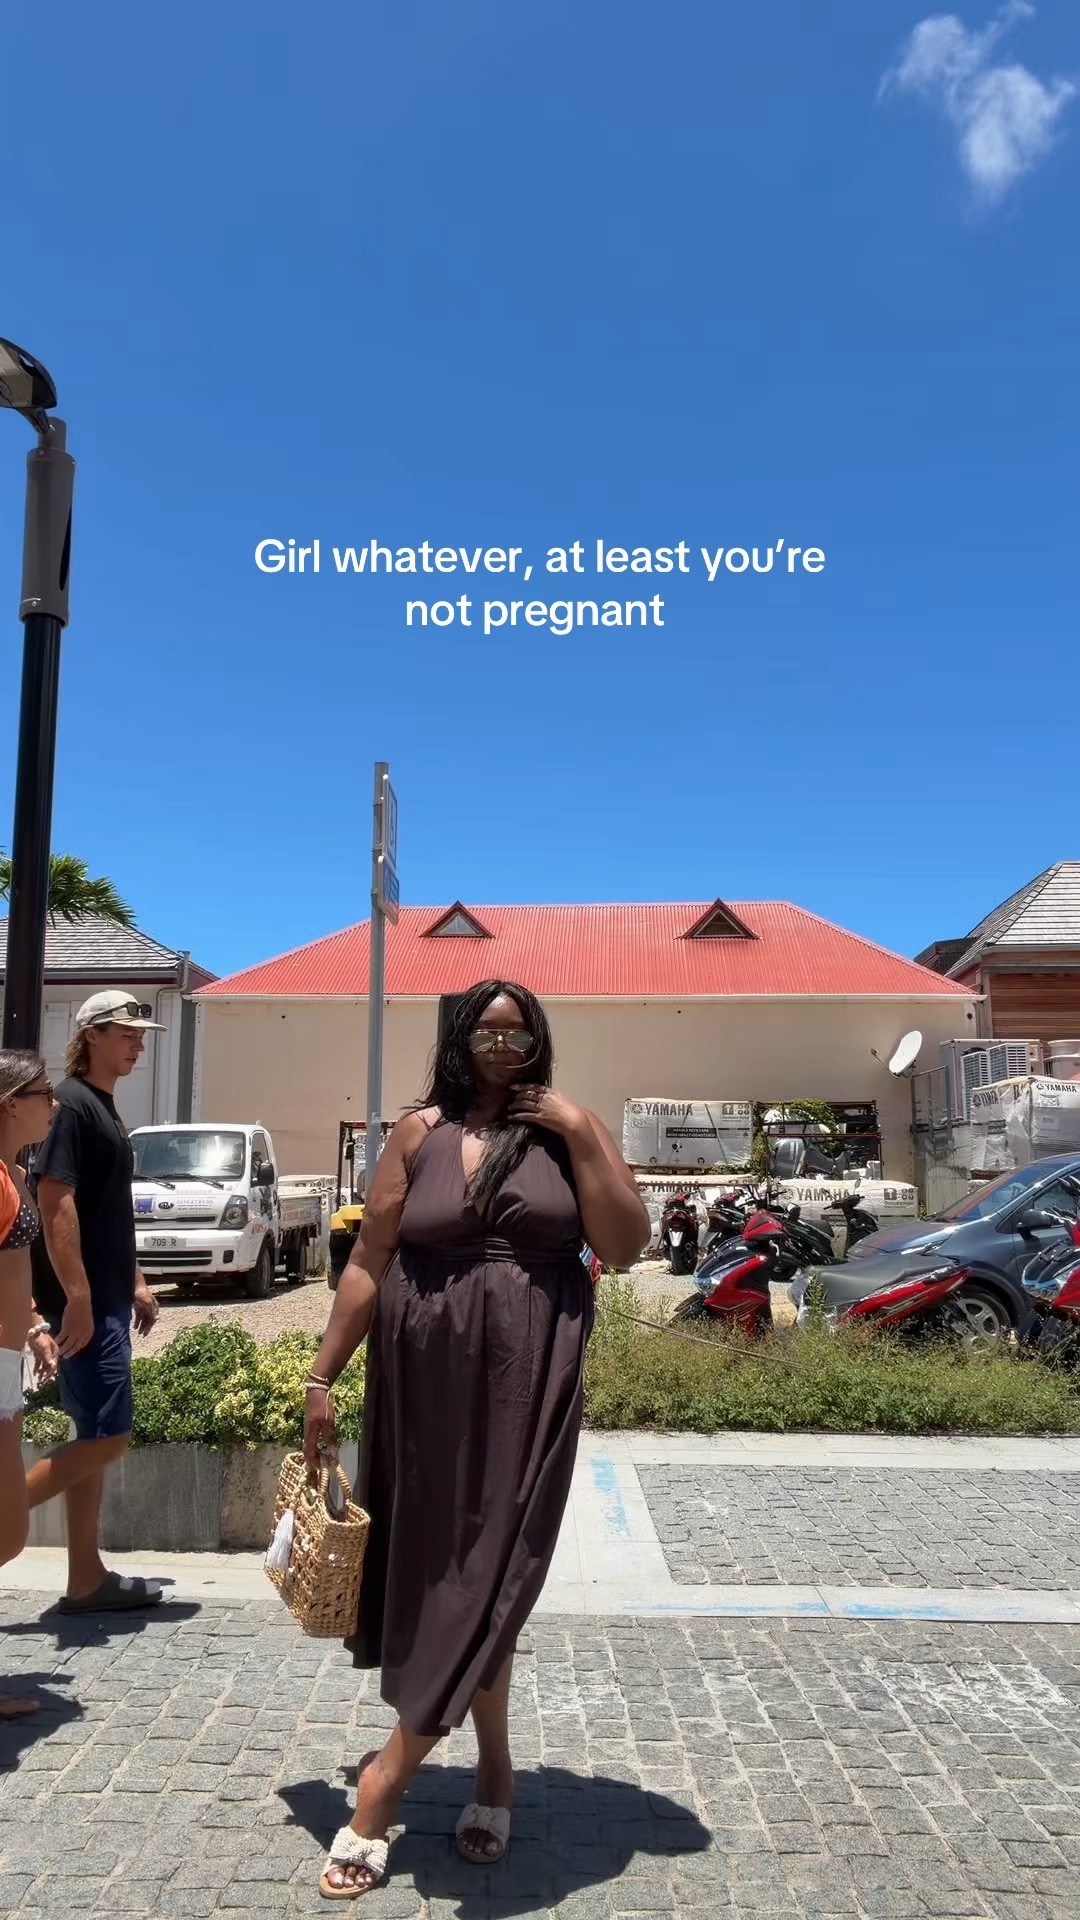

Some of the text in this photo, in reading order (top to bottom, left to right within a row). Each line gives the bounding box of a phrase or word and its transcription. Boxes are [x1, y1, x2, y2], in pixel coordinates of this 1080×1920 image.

[1043, 1083, 1077, 1093] YAMAHA
[645, 1103, 693, 1116] YAMAHA
[797, 1187, 850, 1201] YAMAHA
